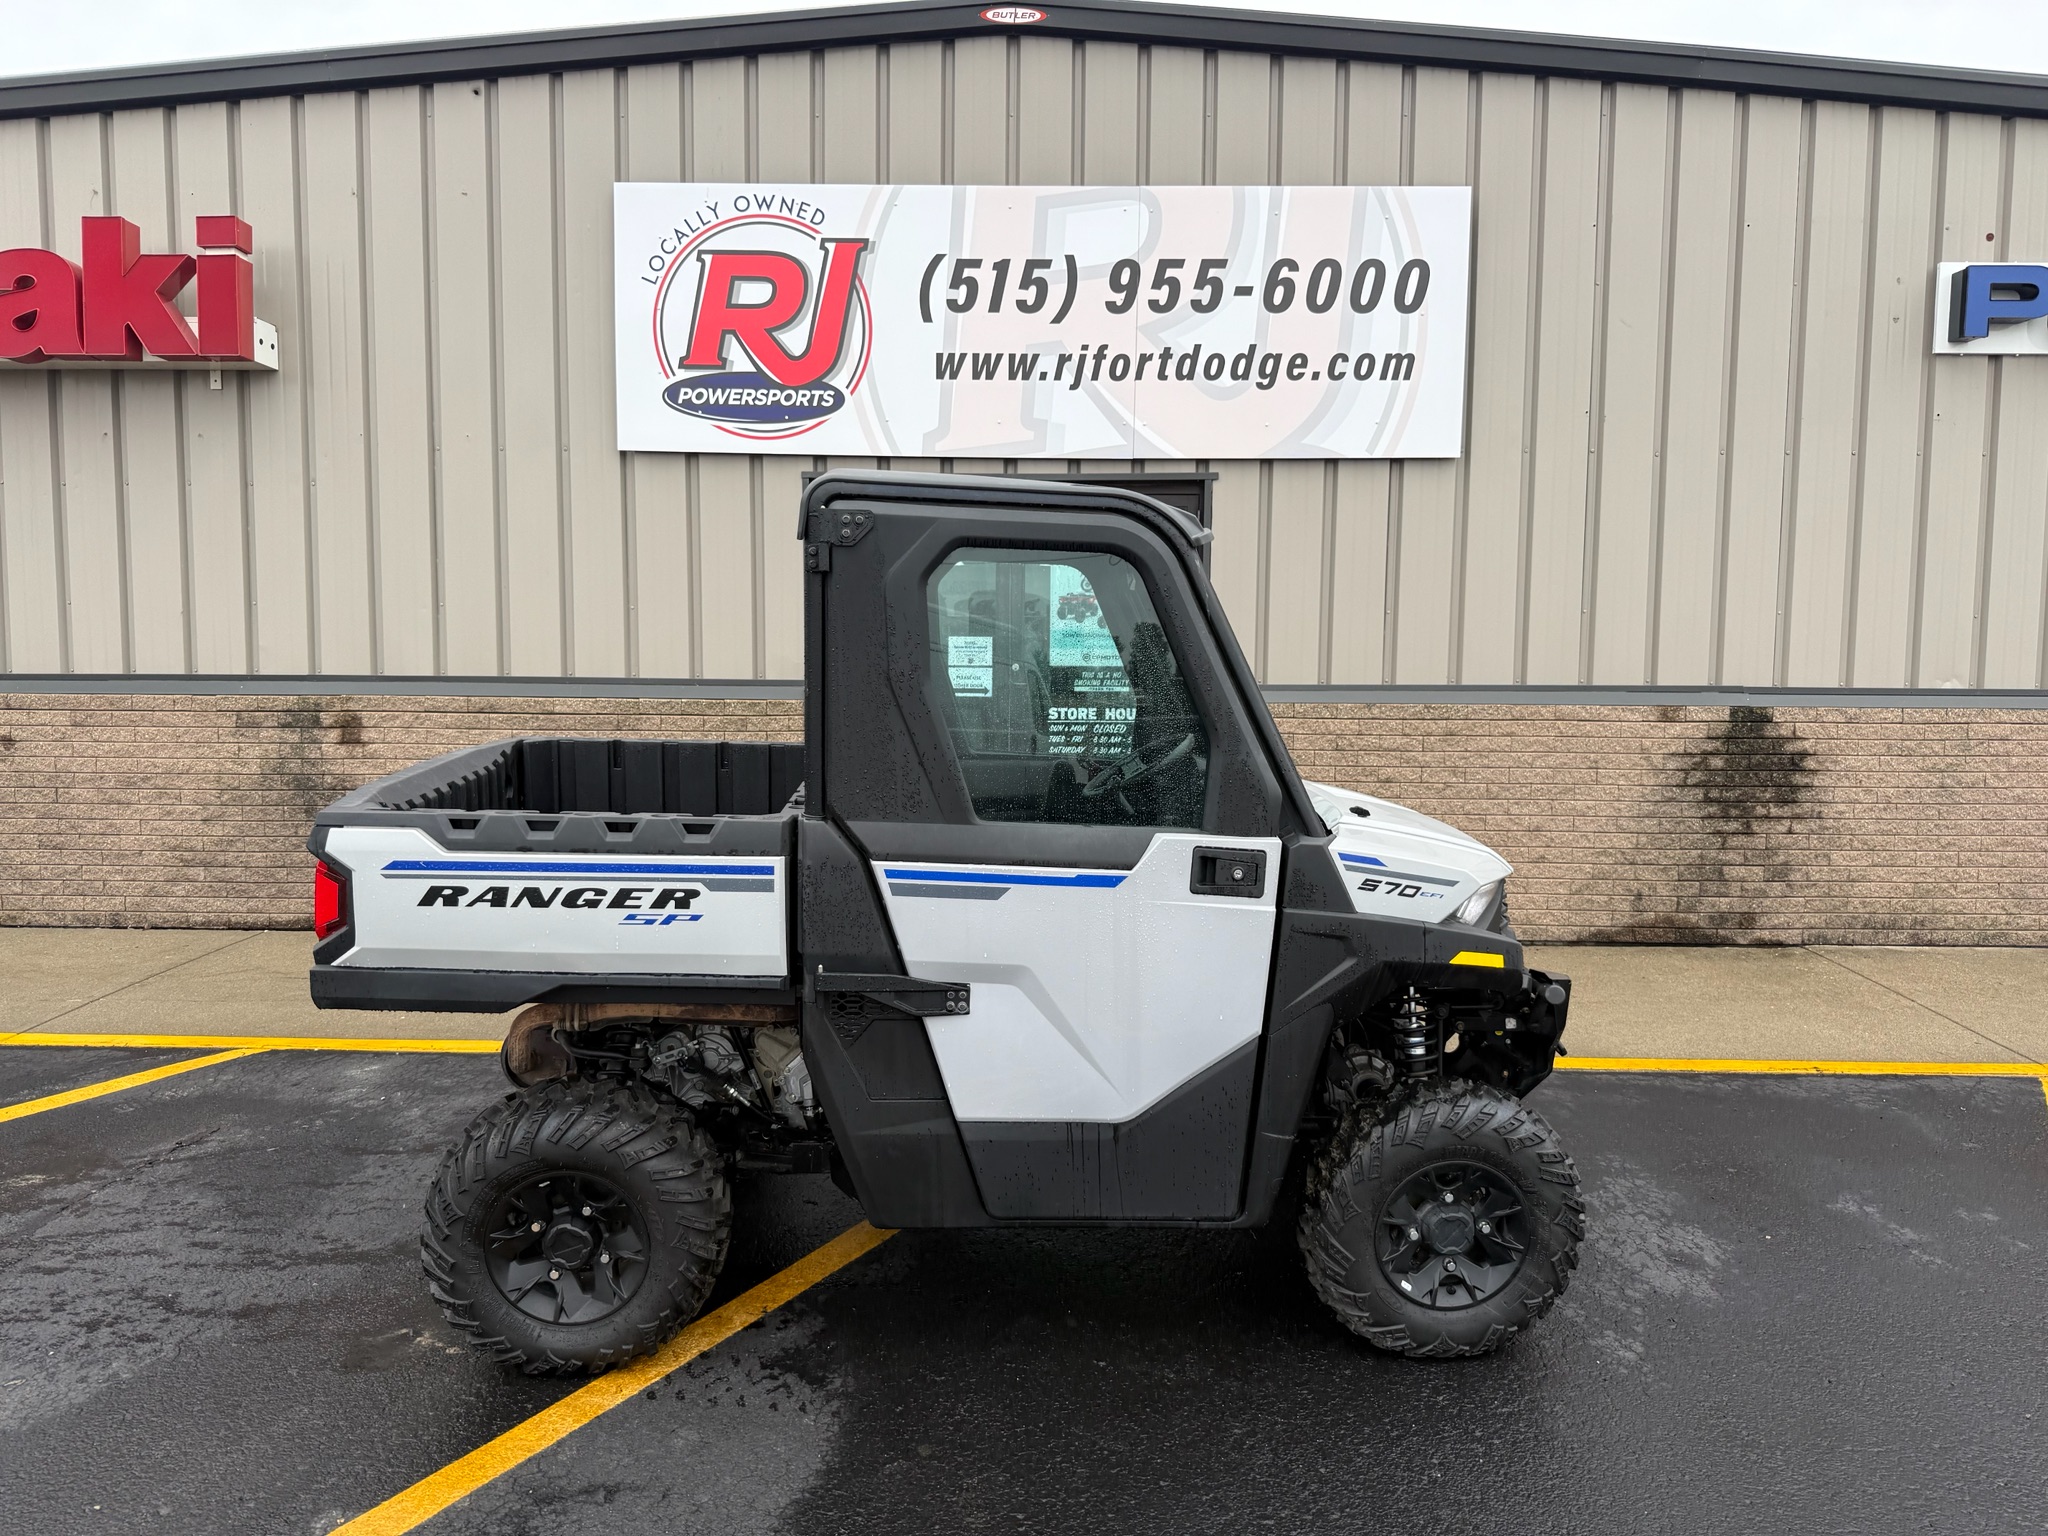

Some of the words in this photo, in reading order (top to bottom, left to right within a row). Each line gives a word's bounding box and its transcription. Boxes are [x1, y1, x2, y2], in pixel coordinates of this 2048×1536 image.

[992, 11, 1036, 19] BUTLER
[641, 201, 719, 285] LOCALLY
[733, 194, 826, 226] OWNED
[919, 253, 1079, 324] (515)
[1104, 257, 1431, 315] 955-6000
[678, 238, 872, 388] RJ
[1947, 265, 2048, 343] P
[935, 344, 1416, 391] www.rjfortdodge.com
[677, 387, 836, 408] POWERSPORTS
[1048, 707, 1097, 720] STORE
[1049, 724, 1064, 732] SUN
[1070, 724, 1088, 732] MON
[1093, 724, 1127, 733] CLOSED
[1049, 745, 1087, 753] SATURDAY
[417, 885, 701, 909] RANGER
[1357, 878, 1422, 898] 570
[1420, 891, 1444, 899] EFI
[618, 913, 704, 925] SP
